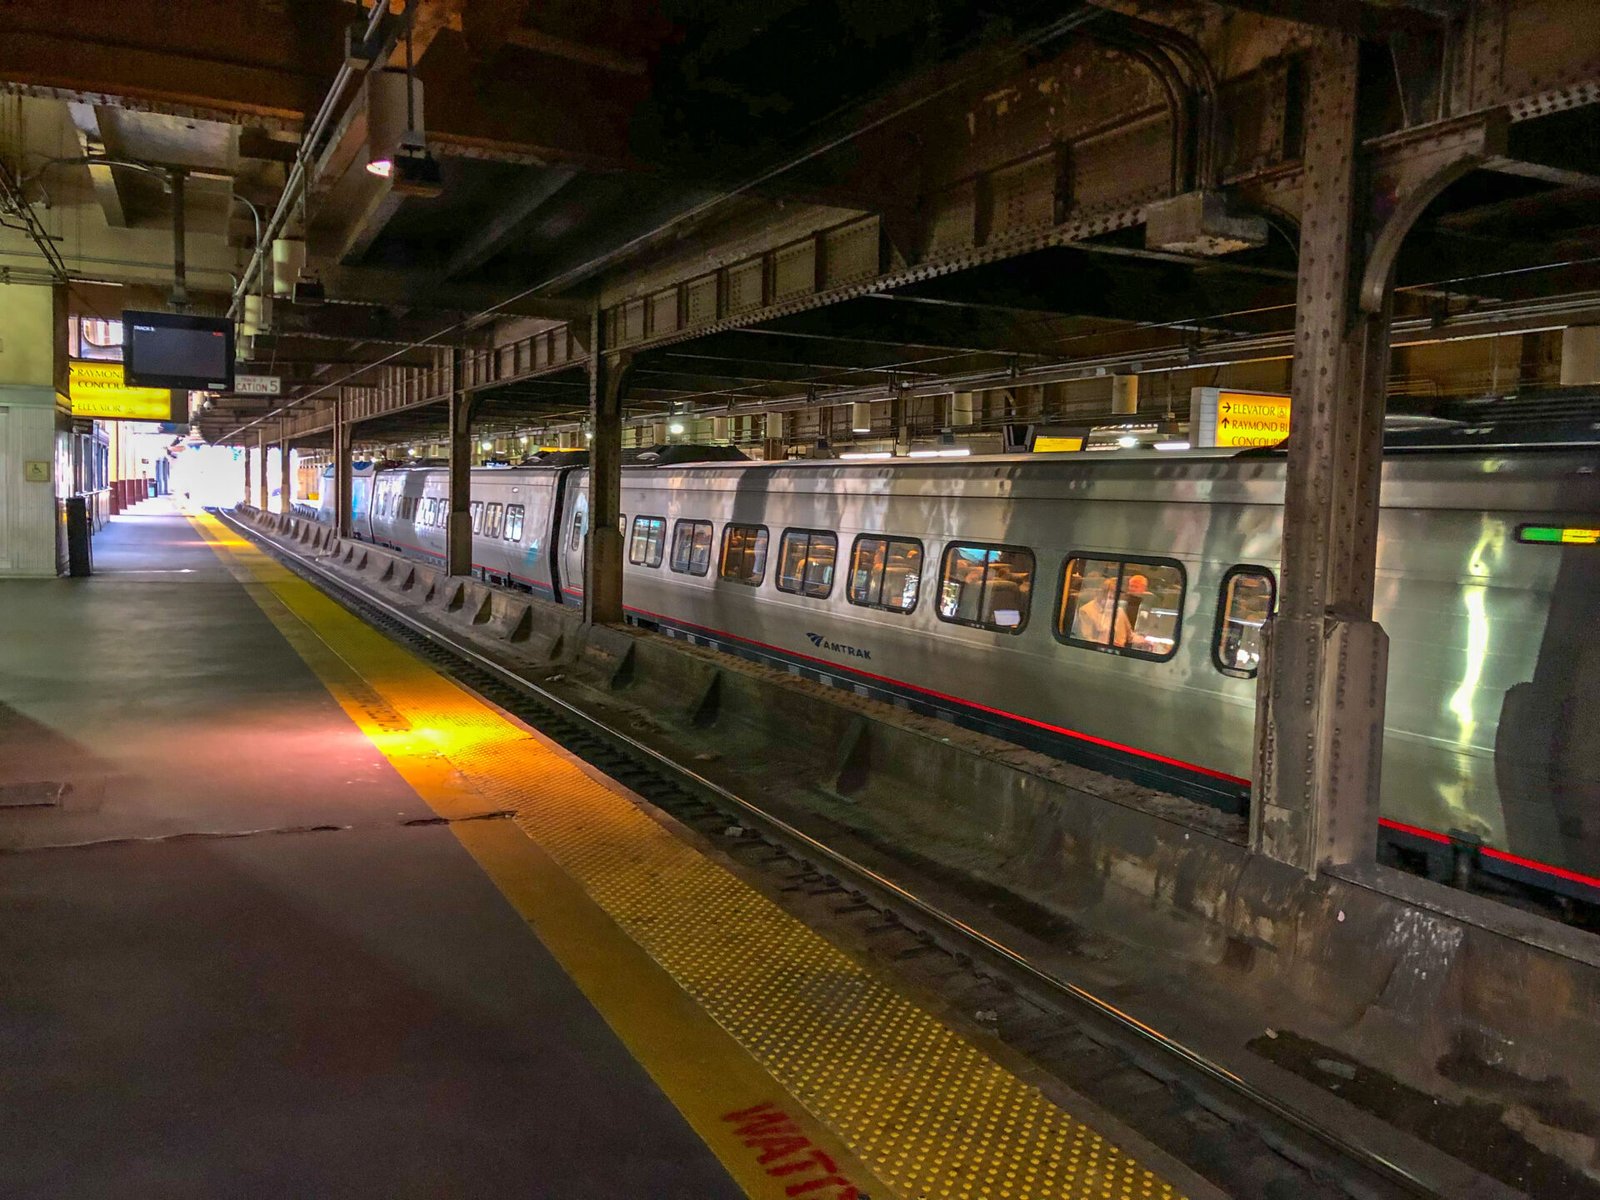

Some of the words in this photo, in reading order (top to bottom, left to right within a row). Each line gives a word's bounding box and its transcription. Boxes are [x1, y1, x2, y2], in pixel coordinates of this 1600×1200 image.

[235, 383, 268, 392] CATION
[270, 380, 278, 392] 5
[1233, 403, 1275, 416] ELEVATOR
[1232, 419, 1278, 432] RAYMOND
[1279, 422, 1288, 432] BL
[823, 640, 871, 660] AMTRAK
